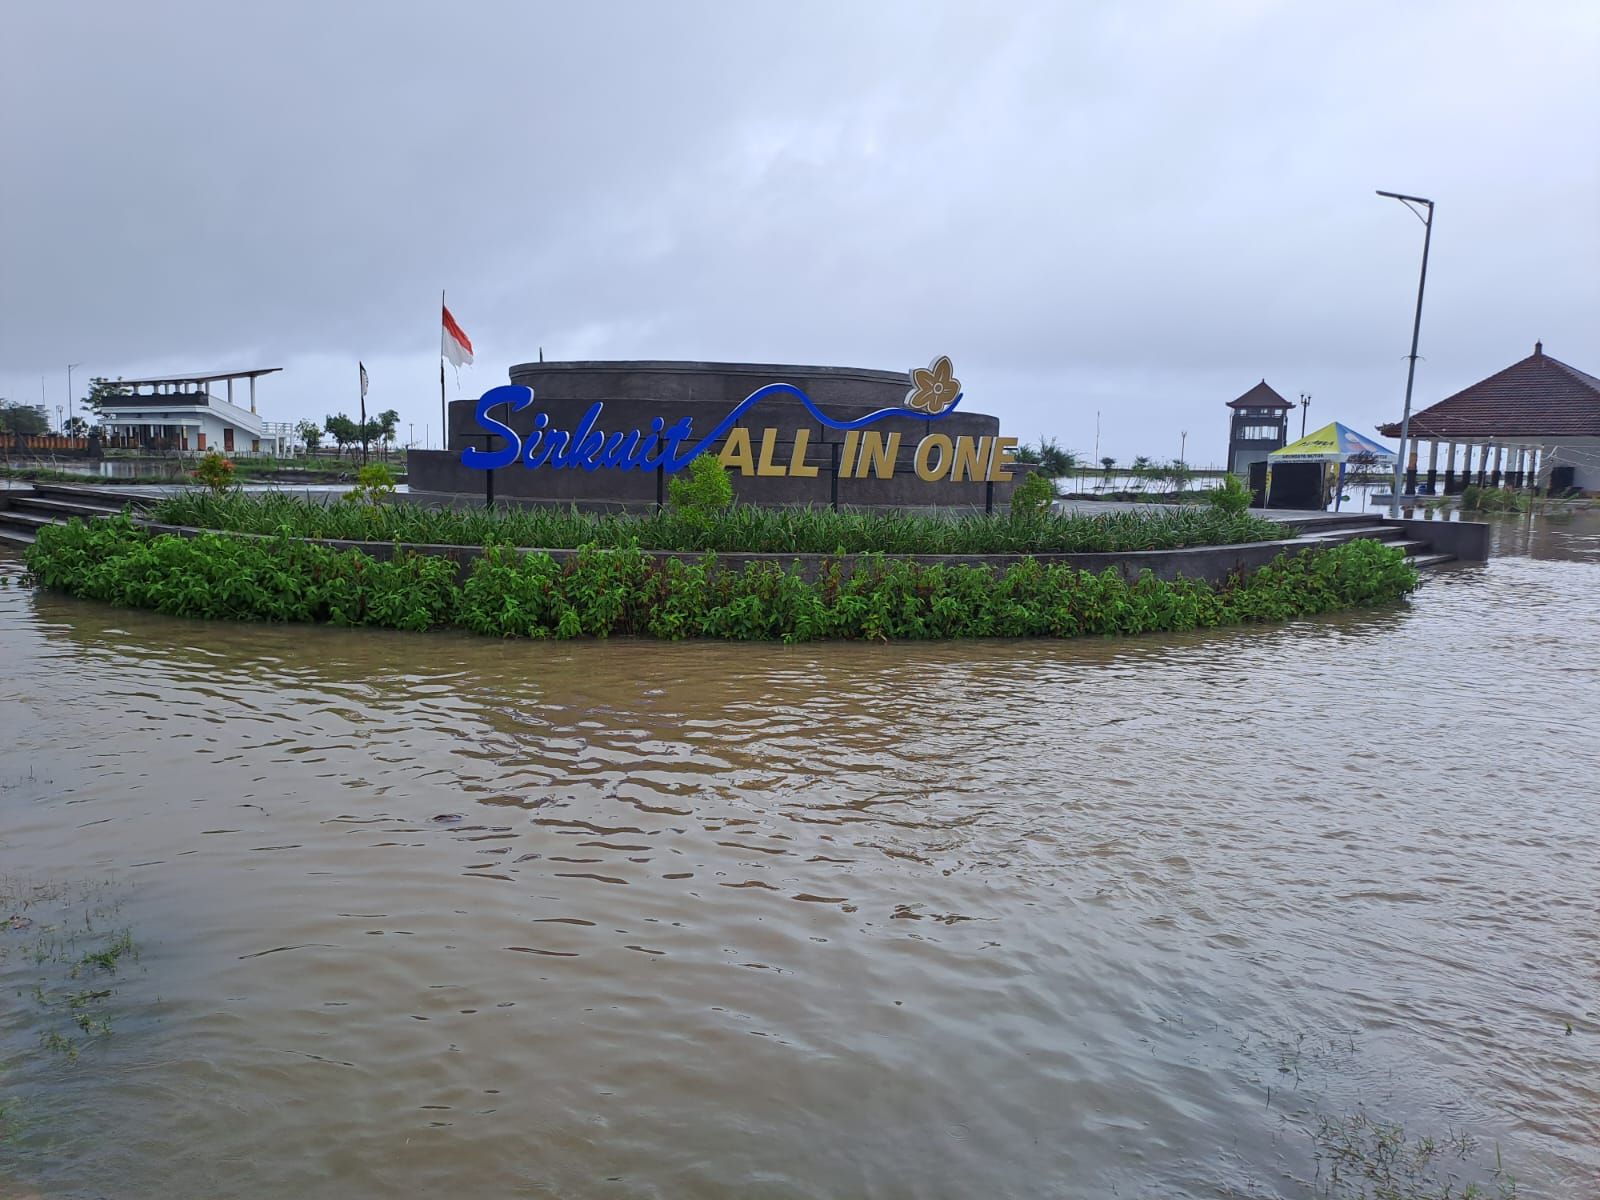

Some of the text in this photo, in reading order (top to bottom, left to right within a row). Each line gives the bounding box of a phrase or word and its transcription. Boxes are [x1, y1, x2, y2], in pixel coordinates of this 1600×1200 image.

[461, 385, 708, 473] Sirkuit
[718, 427, 1018, 482] ALL IN ONE
